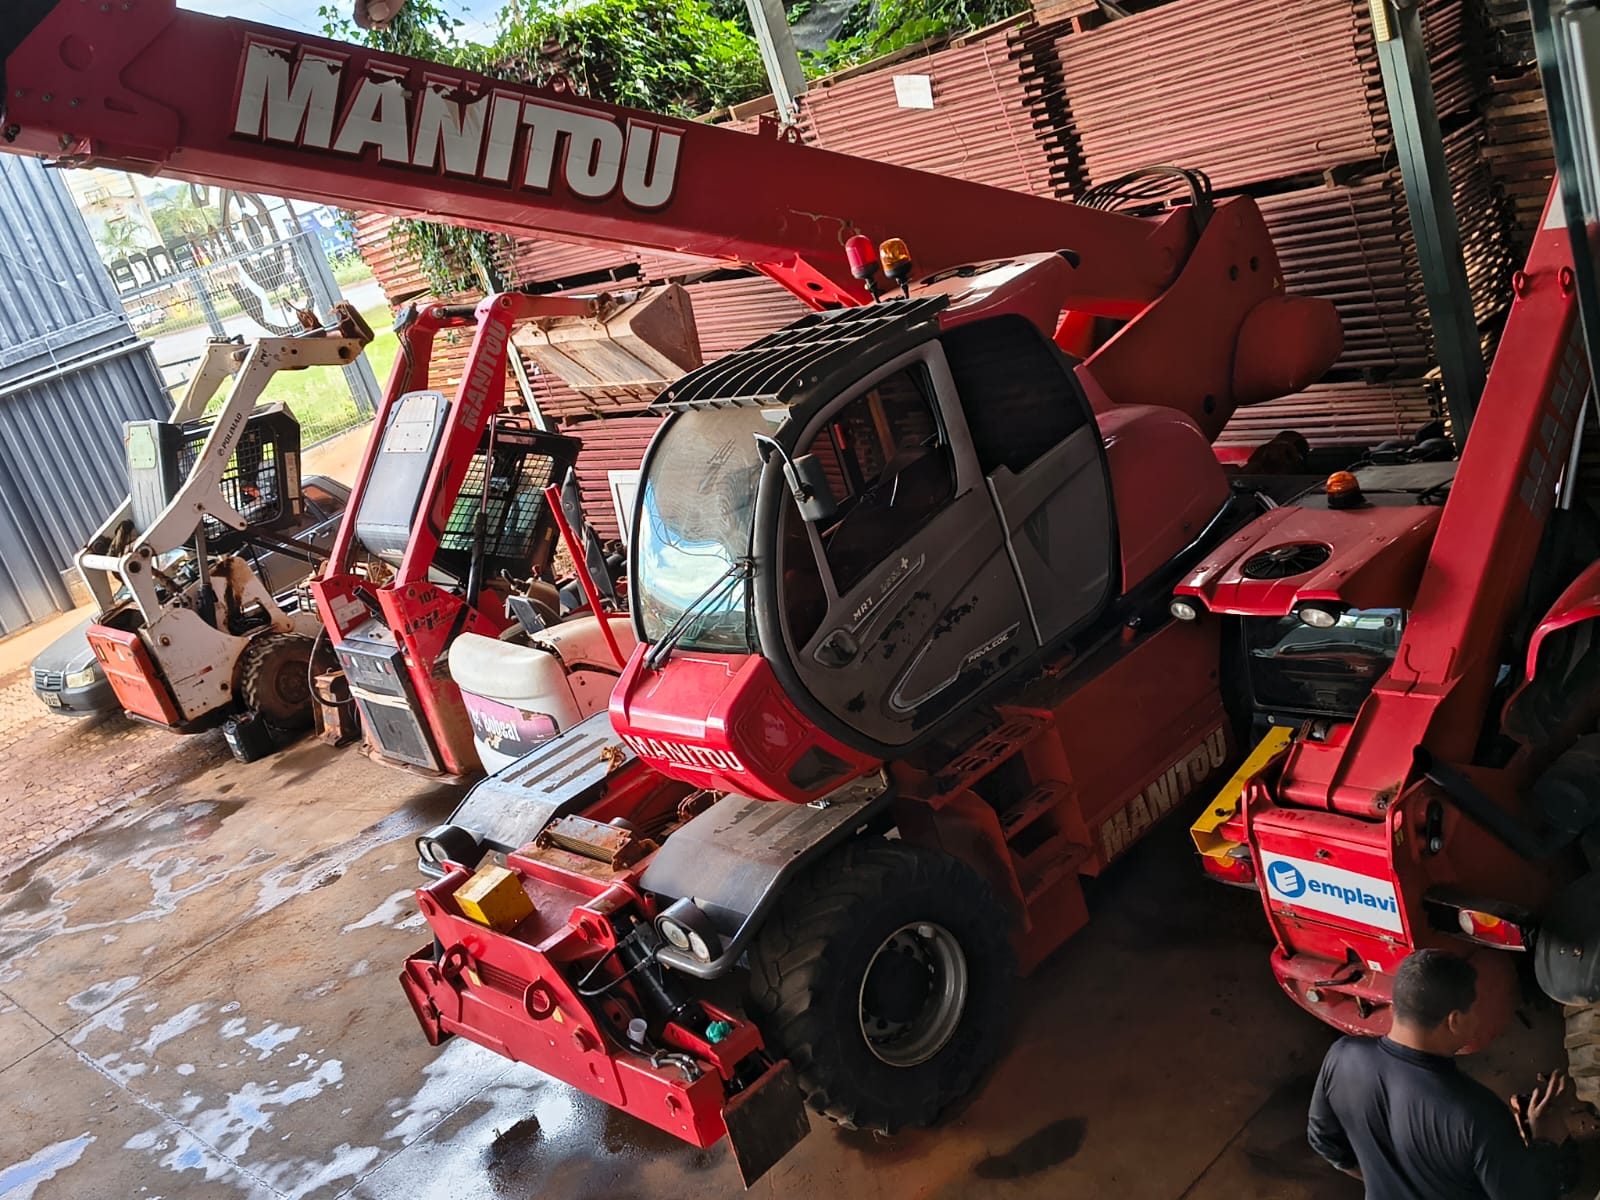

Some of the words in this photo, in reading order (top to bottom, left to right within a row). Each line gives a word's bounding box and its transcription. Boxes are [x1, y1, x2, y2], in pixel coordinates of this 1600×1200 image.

[231, 35, 684, 208] MANITOU
[461, 320, 507, 432] MANITOU
[624, 735, 745, 774] MANITOU
[1101, 726, 1228, 862] MANITOU
[1308, 878, 1397, 914] emplavi
